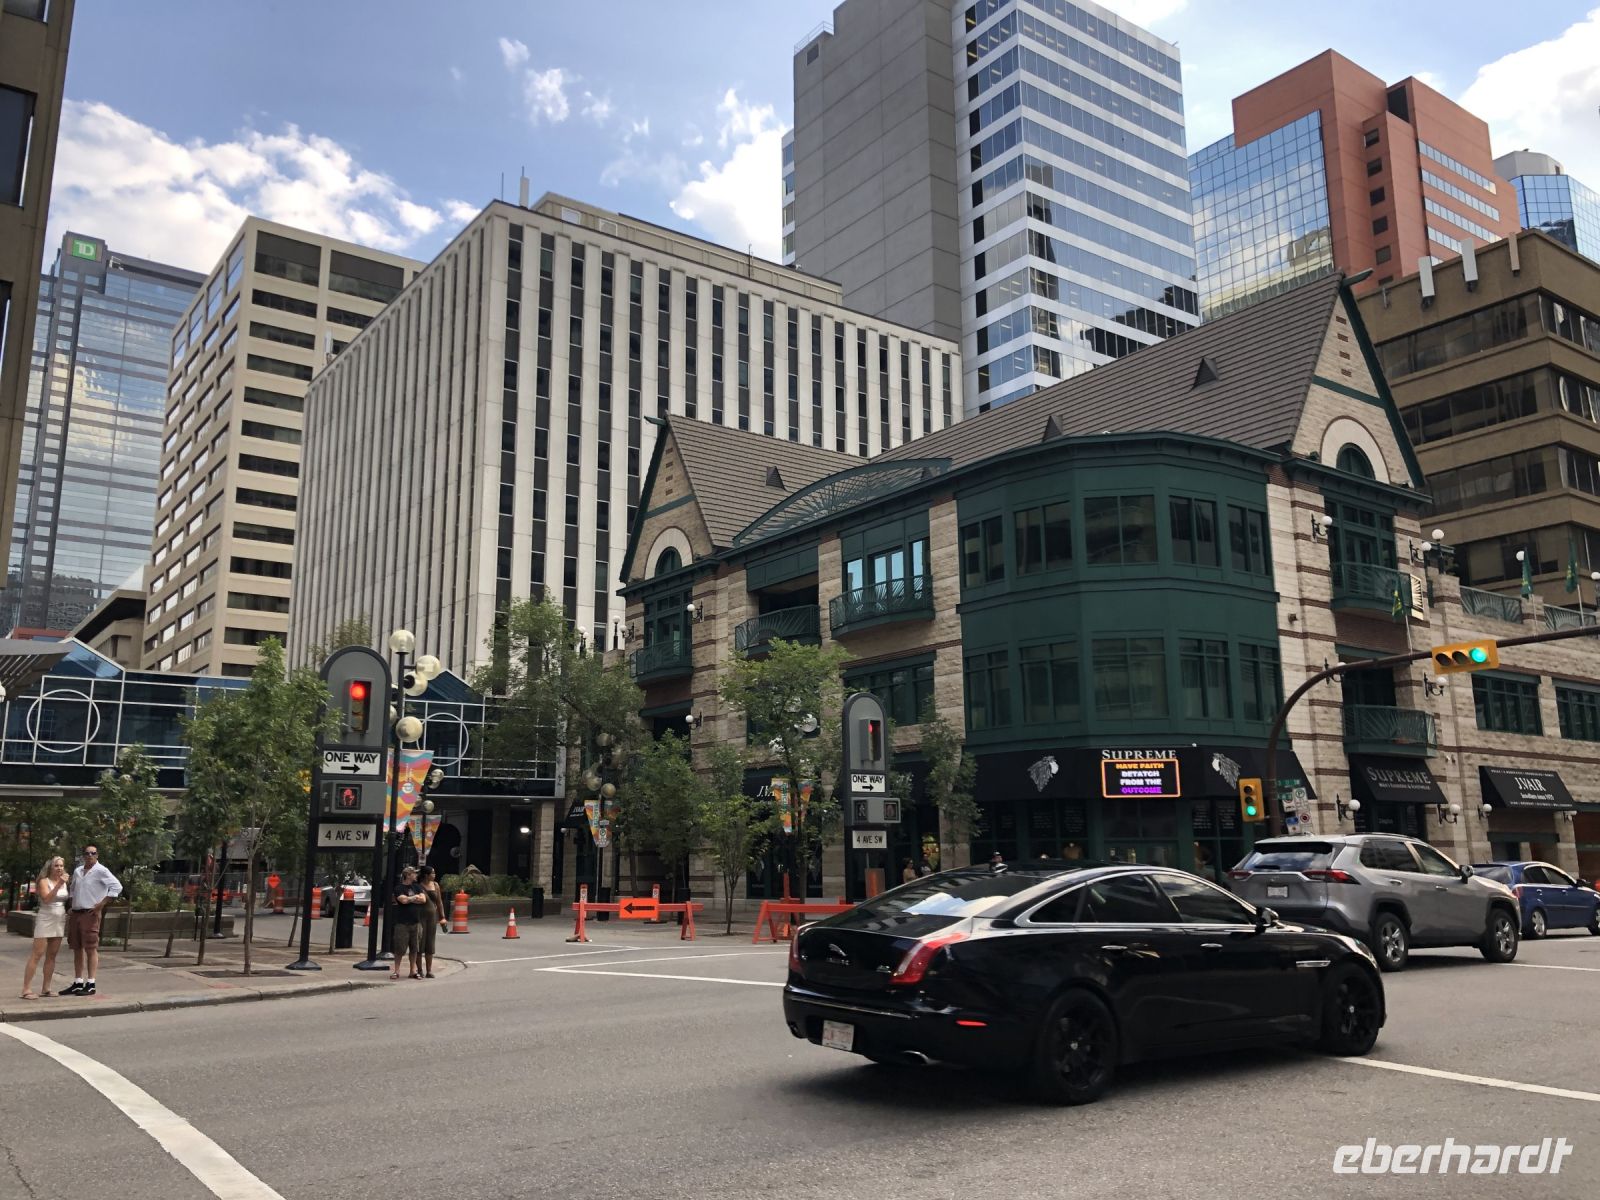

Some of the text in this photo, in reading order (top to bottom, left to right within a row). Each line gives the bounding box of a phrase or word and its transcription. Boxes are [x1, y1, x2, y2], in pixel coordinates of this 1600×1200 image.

[75, 241, 95, 257] TD
[325, 752, 378, 764] ONE WAY
[1102, 749, 1177, 760] SUPREME
[852, 775, 884, 784] ONE WAY
[1367, 766, 1431, 784] SUPREME
[1514, 777, 1547, 791] J.VAIR
[325, 830, 370, 841] 4 AVE SW
